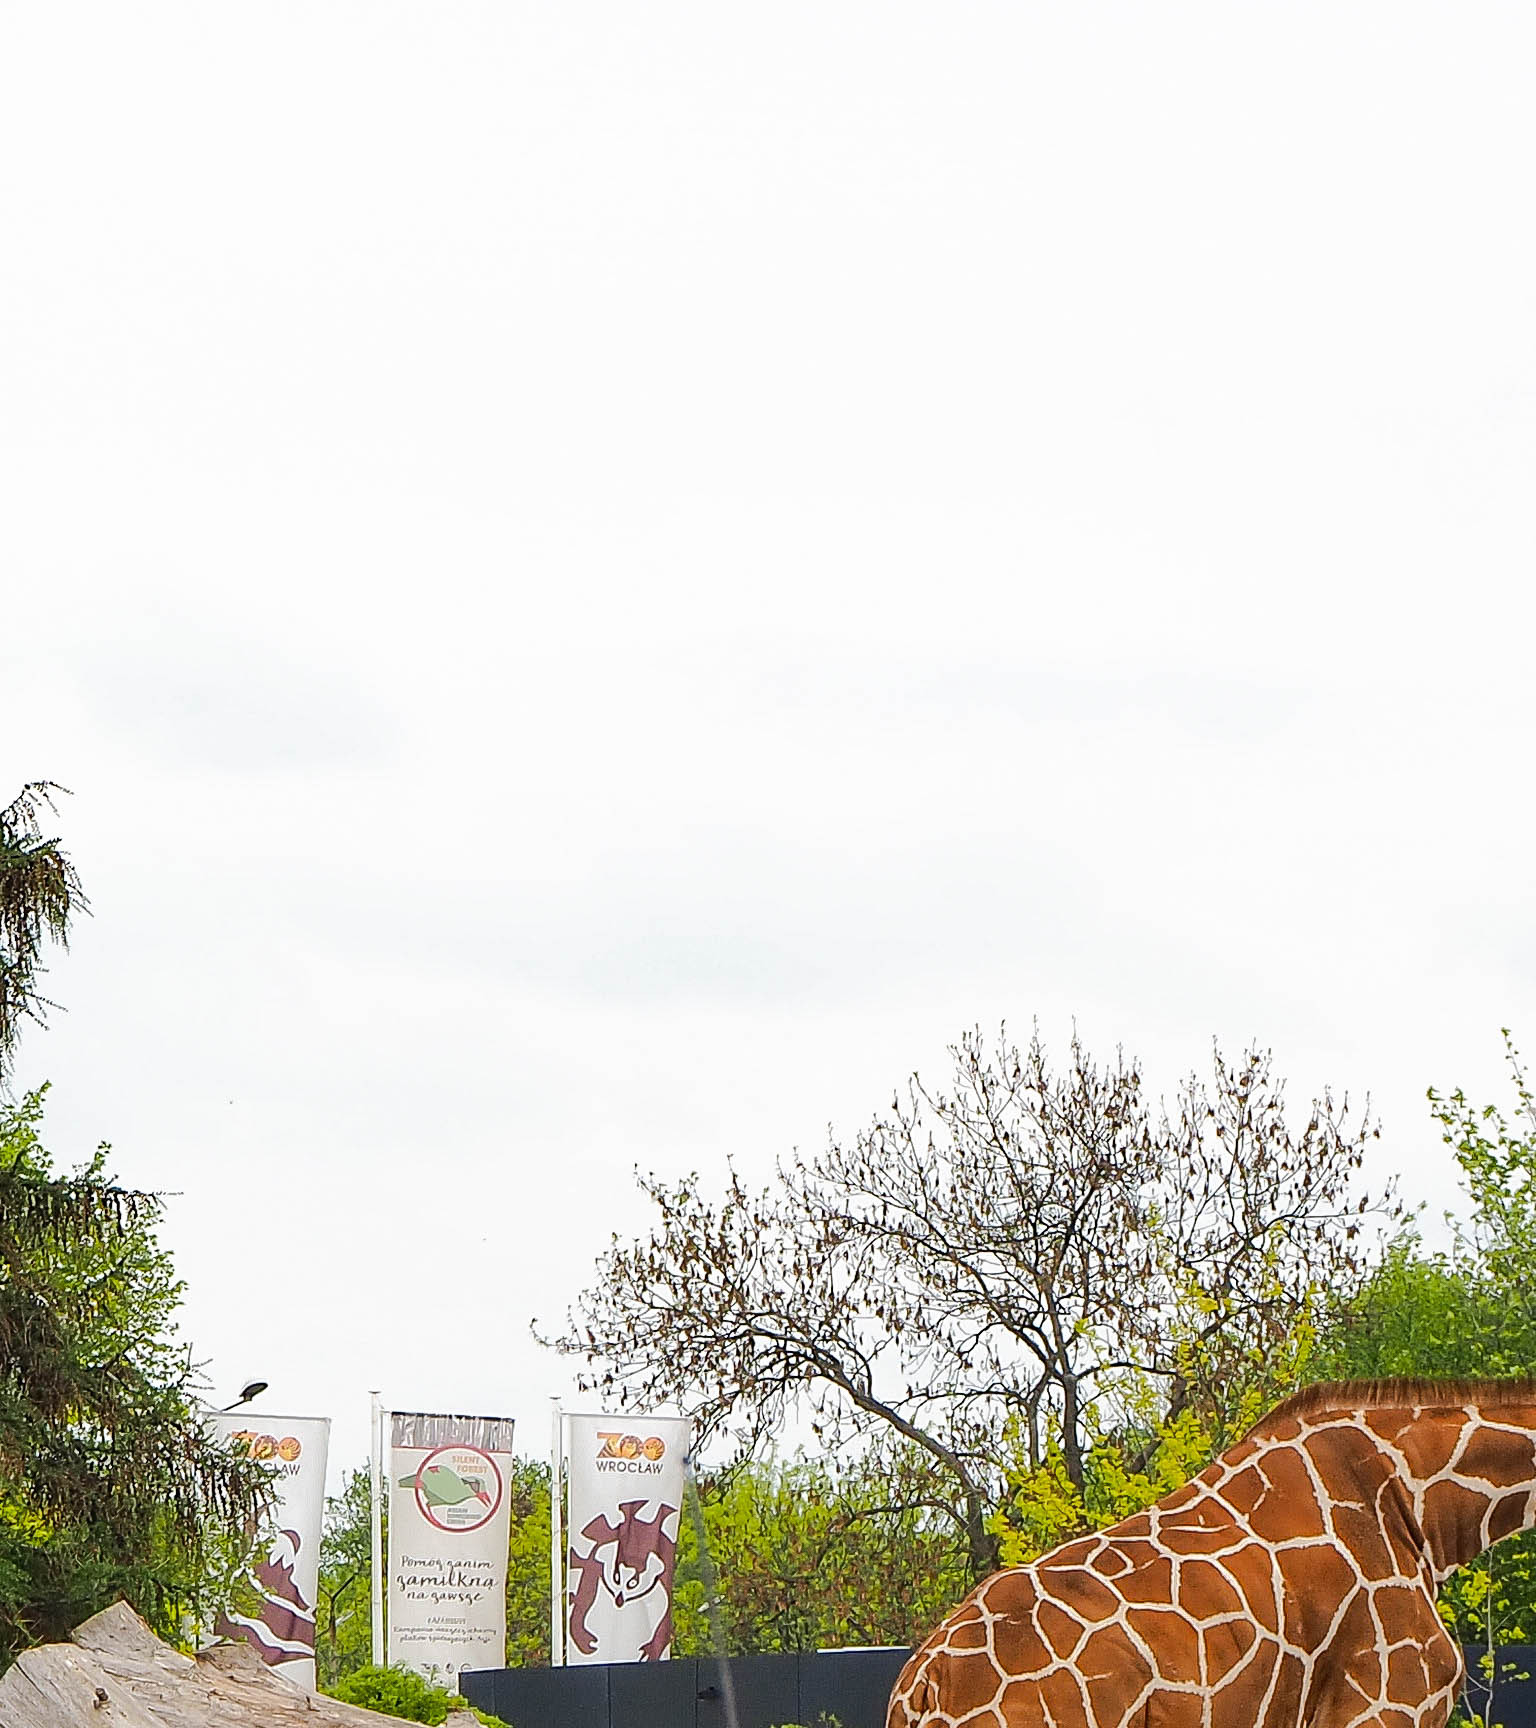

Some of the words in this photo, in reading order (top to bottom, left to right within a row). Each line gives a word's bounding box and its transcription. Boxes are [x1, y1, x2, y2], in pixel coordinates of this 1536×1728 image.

[596, 1432, 665, 1462] ZOO
[595, 1461, 664, 1475] WROCŁAW
[396, 1568, 499, 1591] zamilkną
[407, 1591, 429, 1600] na
